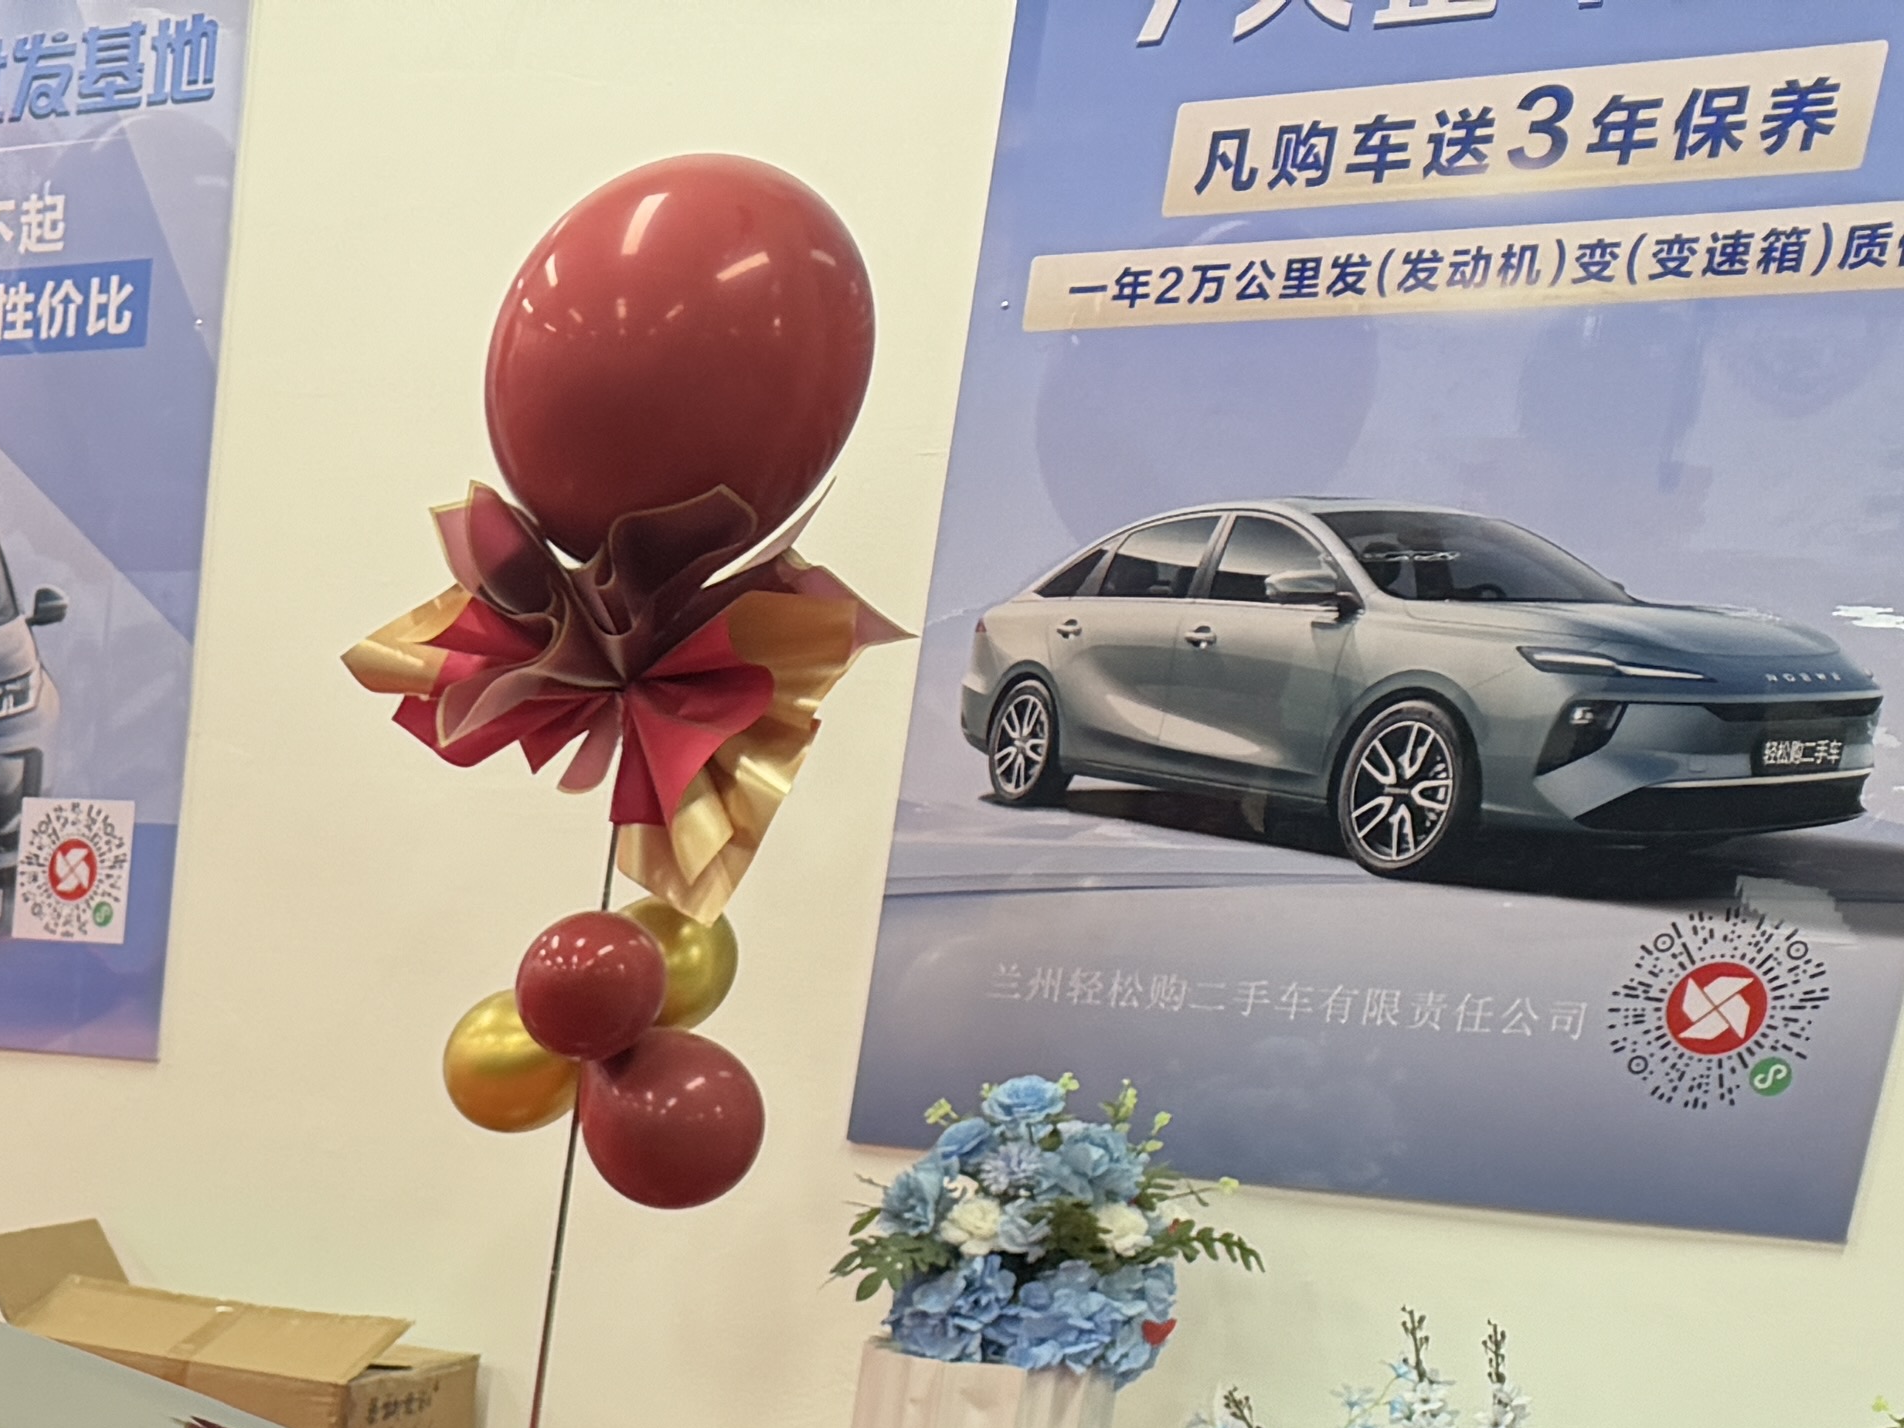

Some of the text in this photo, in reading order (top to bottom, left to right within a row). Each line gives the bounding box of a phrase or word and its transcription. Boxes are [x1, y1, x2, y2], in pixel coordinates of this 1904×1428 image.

[1194, 77, 1842, 195] 凡购车送3年保养
[1068, 221, 1904, 309] 一年2万公里发(发动机)变(变速箱)质
[985, 963, 1589, 1041] 兰州轻松购二手车有限责任公司
